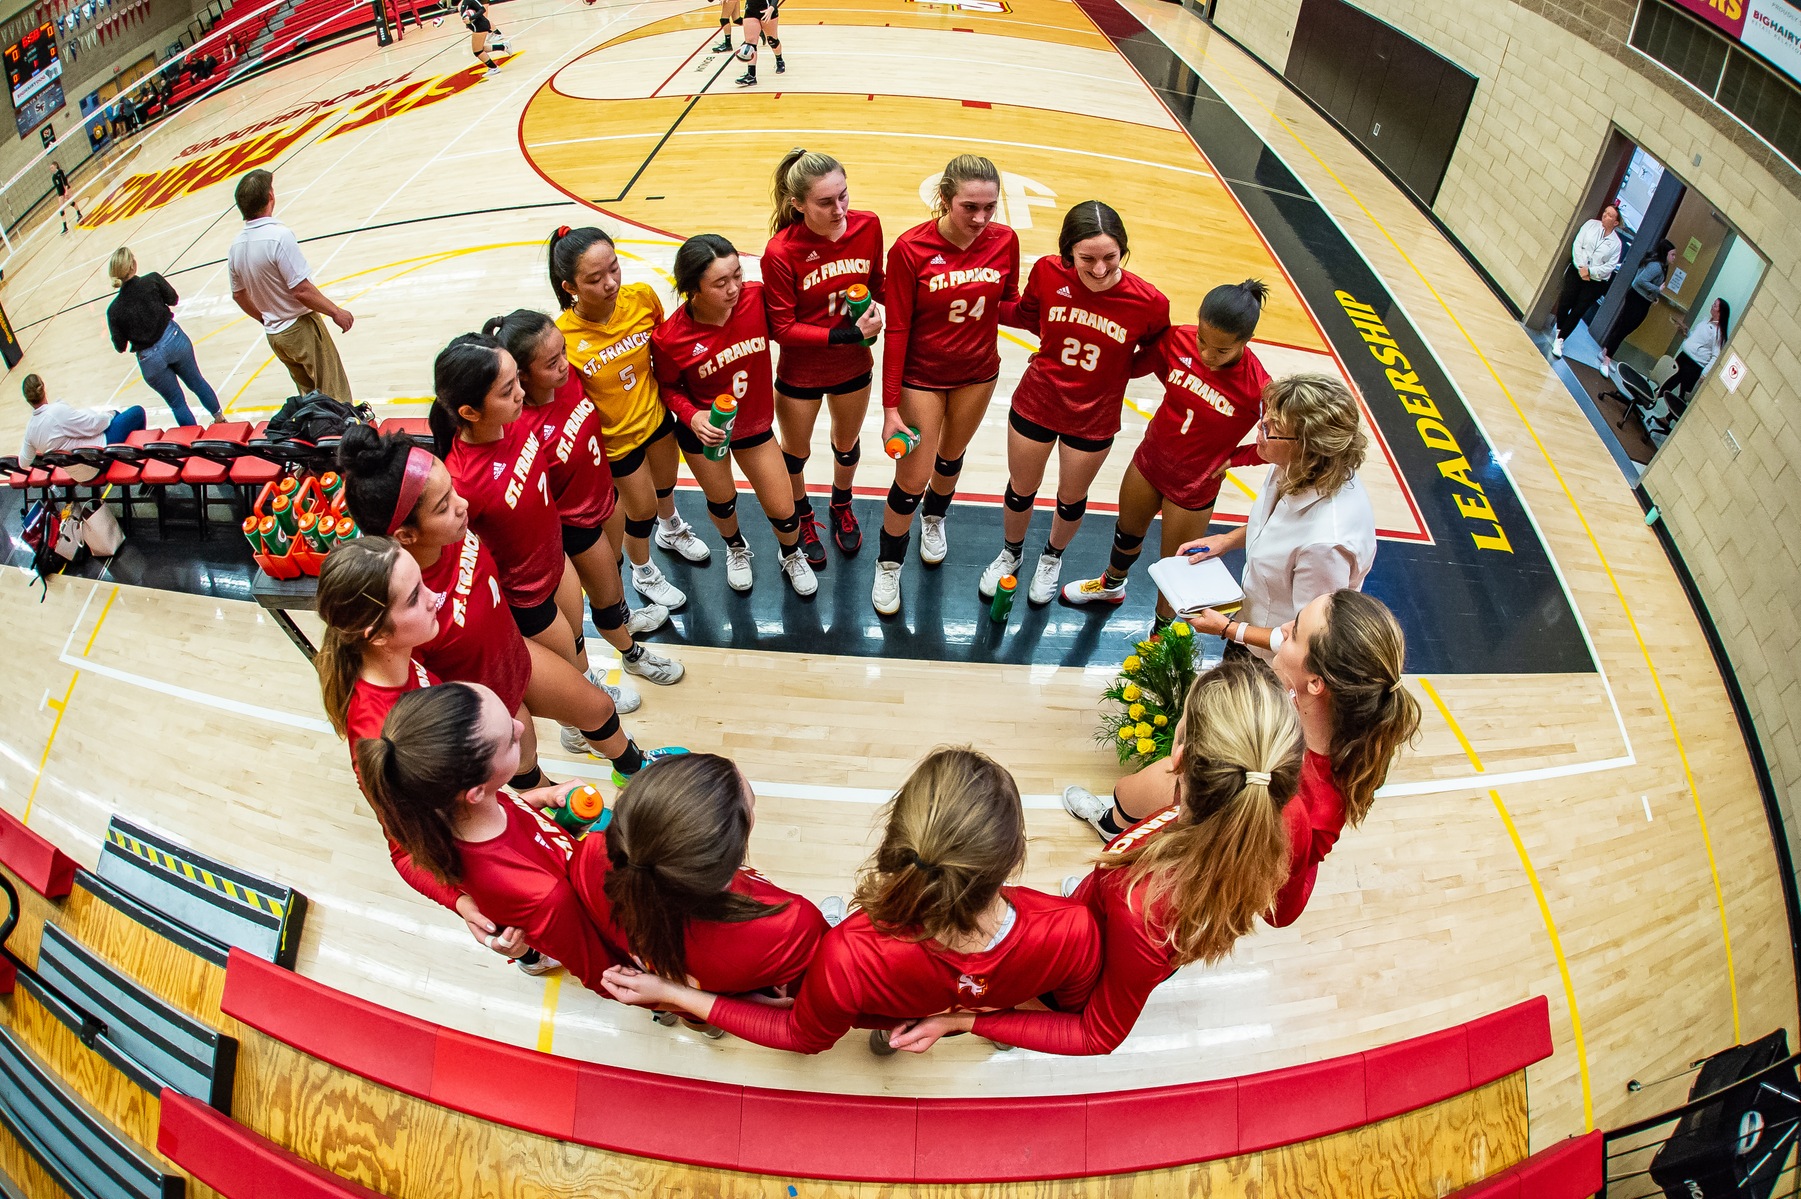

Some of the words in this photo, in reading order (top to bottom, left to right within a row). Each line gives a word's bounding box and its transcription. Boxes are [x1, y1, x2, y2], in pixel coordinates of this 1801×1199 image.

[1753, 9, 1801, 49] BIGHAIRY
[803, 269, 821, 291] ST.
[820, 258, 870, 281] FRANCIS
[929, 273, 948, 292] ST.
[949, 267, 1001, 286] FRANCIS
[948, 296, 986, 323] 24
[1048, 306, 1067, 322] ST.
[1068, 307, 1127, 344] FRANCIS
[582, 357, 602, 378] ST.
[698, 359, 717, 379] ST.
[715, 336, 766, 369] FRANCIS
[1061, 337, 1101, 372] 23
[619, 364, 637, 392] 5
[732, 370, 749, 399] 6
[1167, 368, 1185, 386] ST.
[1182, 373, 1235, 417] FRANCIS
[1180, 408, 1194, 435] 1
[1334, 289, 1514, 554] LEADERSHIP
[556, 436, 574, 464] ST.
[588, 435, 601, 466] 3
[504, 477, 524, 510] ST.
[537, 471, 549, 507] 7
